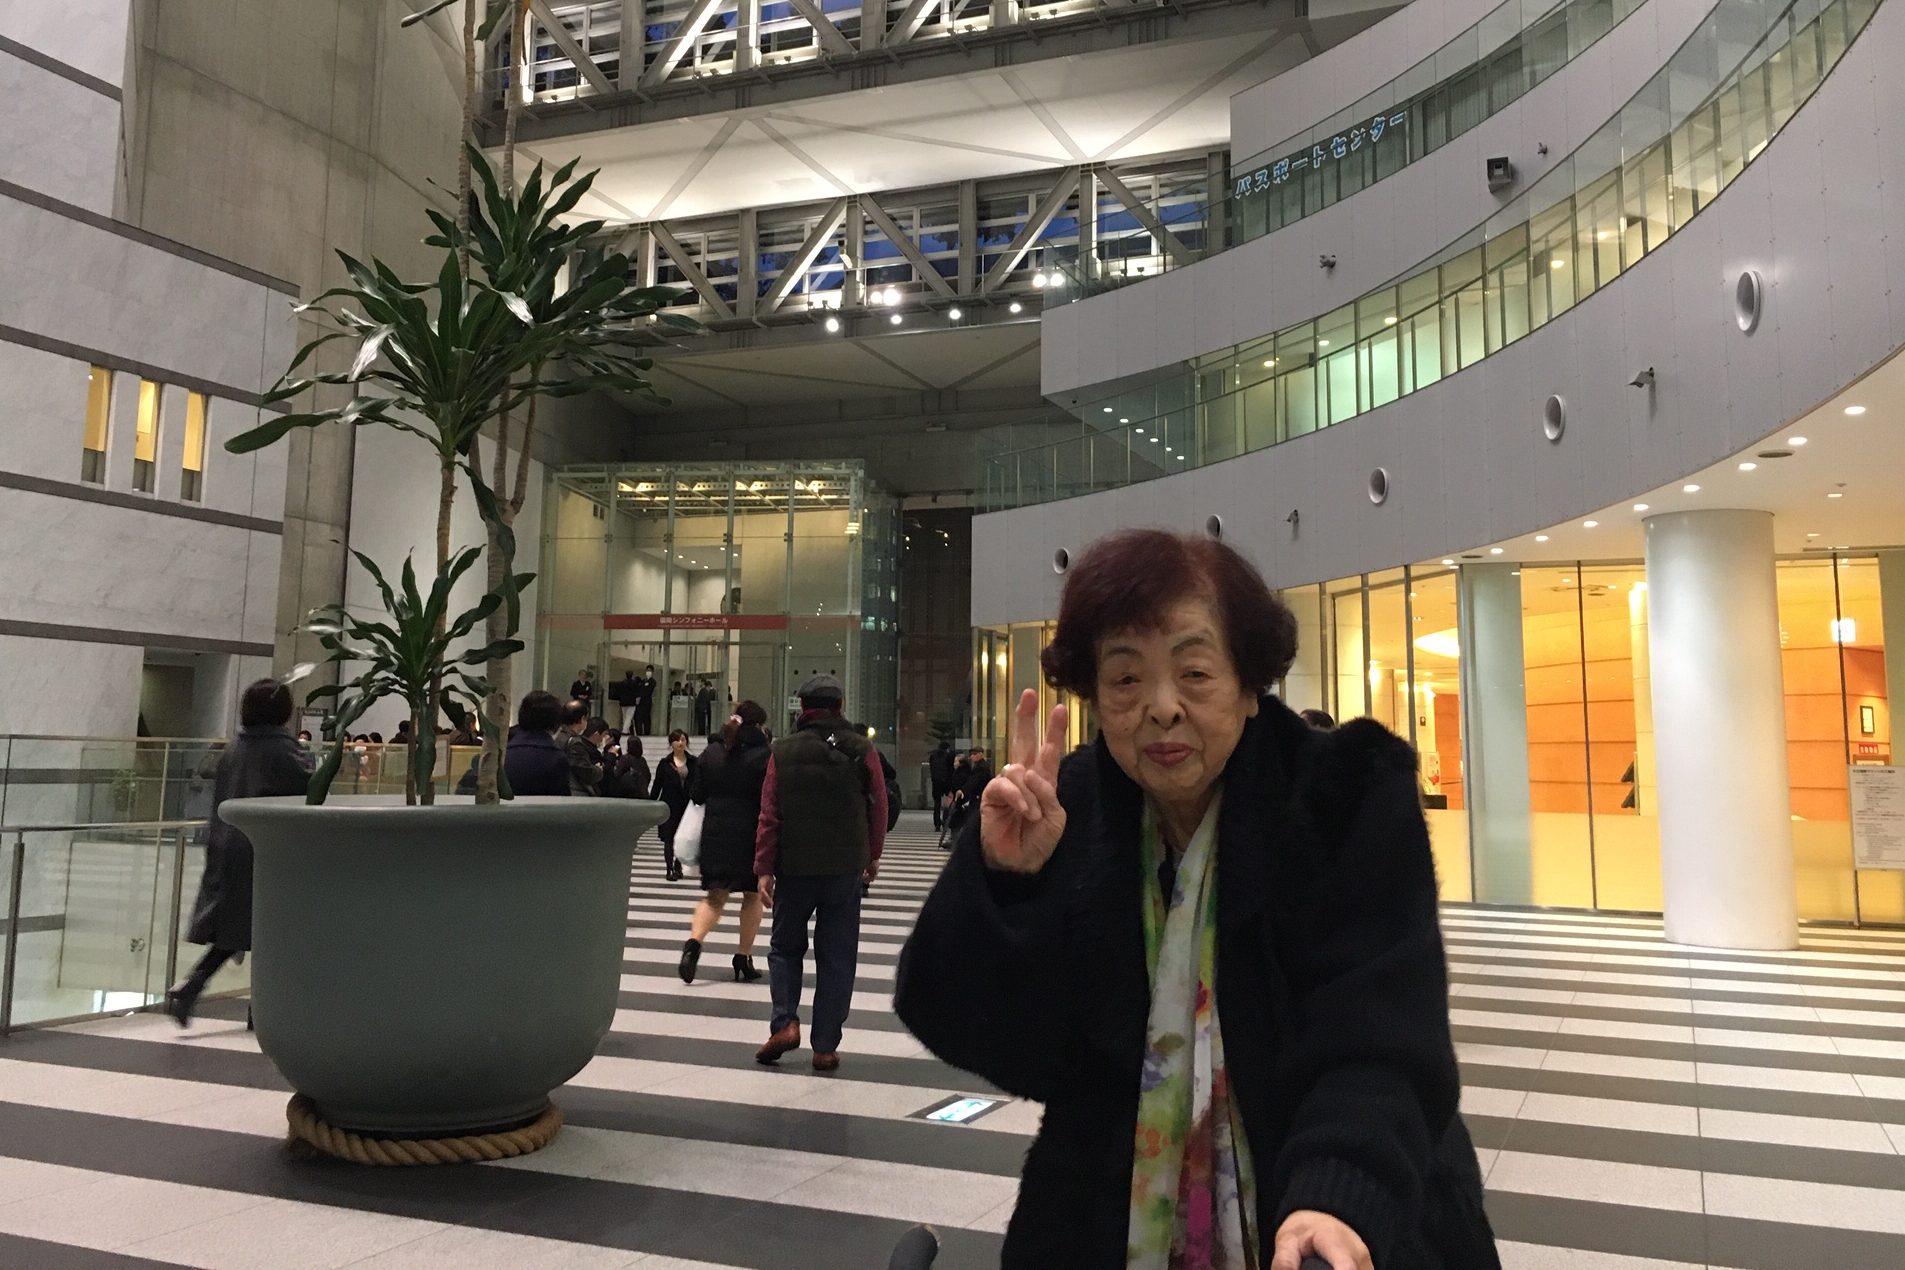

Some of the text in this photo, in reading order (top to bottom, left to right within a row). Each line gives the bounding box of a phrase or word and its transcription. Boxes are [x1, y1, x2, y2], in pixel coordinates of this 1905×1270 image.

[1235, 111, 1407, 199] パスポートセンター
